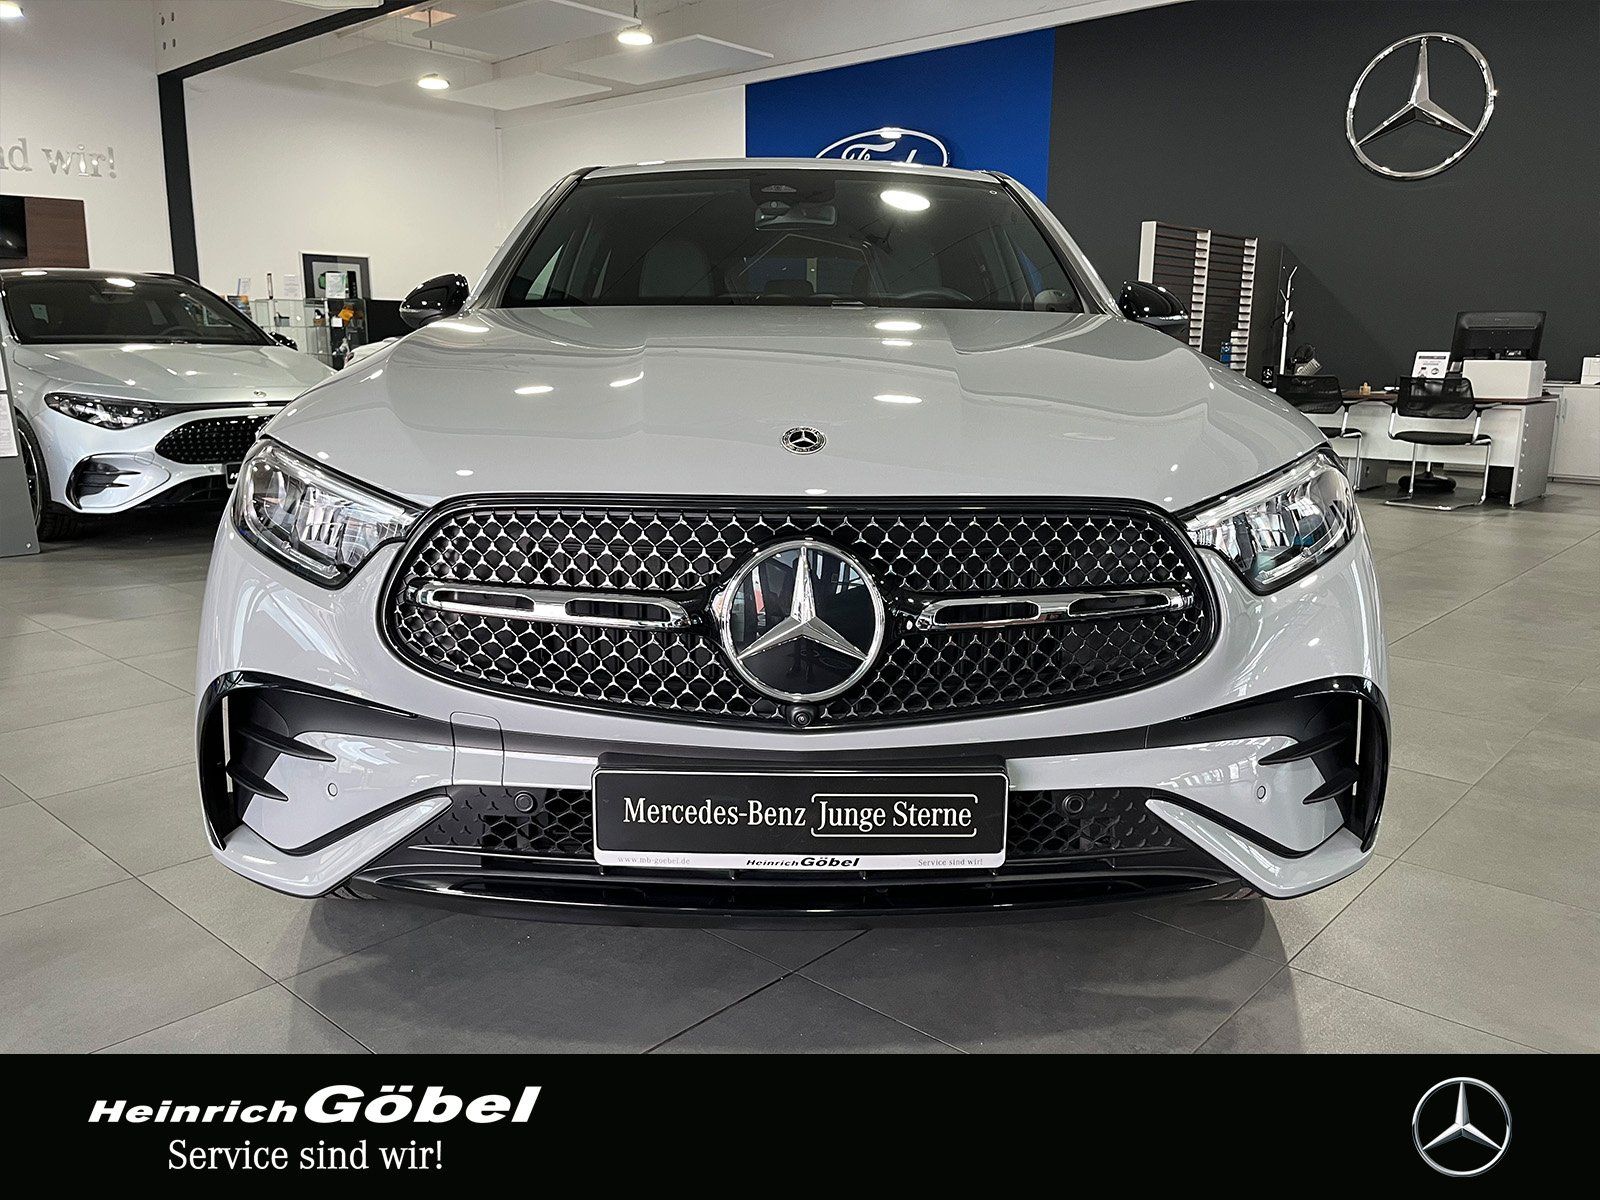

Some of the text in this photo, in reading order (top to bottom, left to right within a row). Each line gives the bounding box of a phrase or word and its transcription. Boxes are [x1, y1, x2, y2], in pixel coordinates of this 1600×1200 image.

[41, 143, 117, 179] wir!
[622, 797, 972, 833] Mercedes-Benz Junge Sterne
